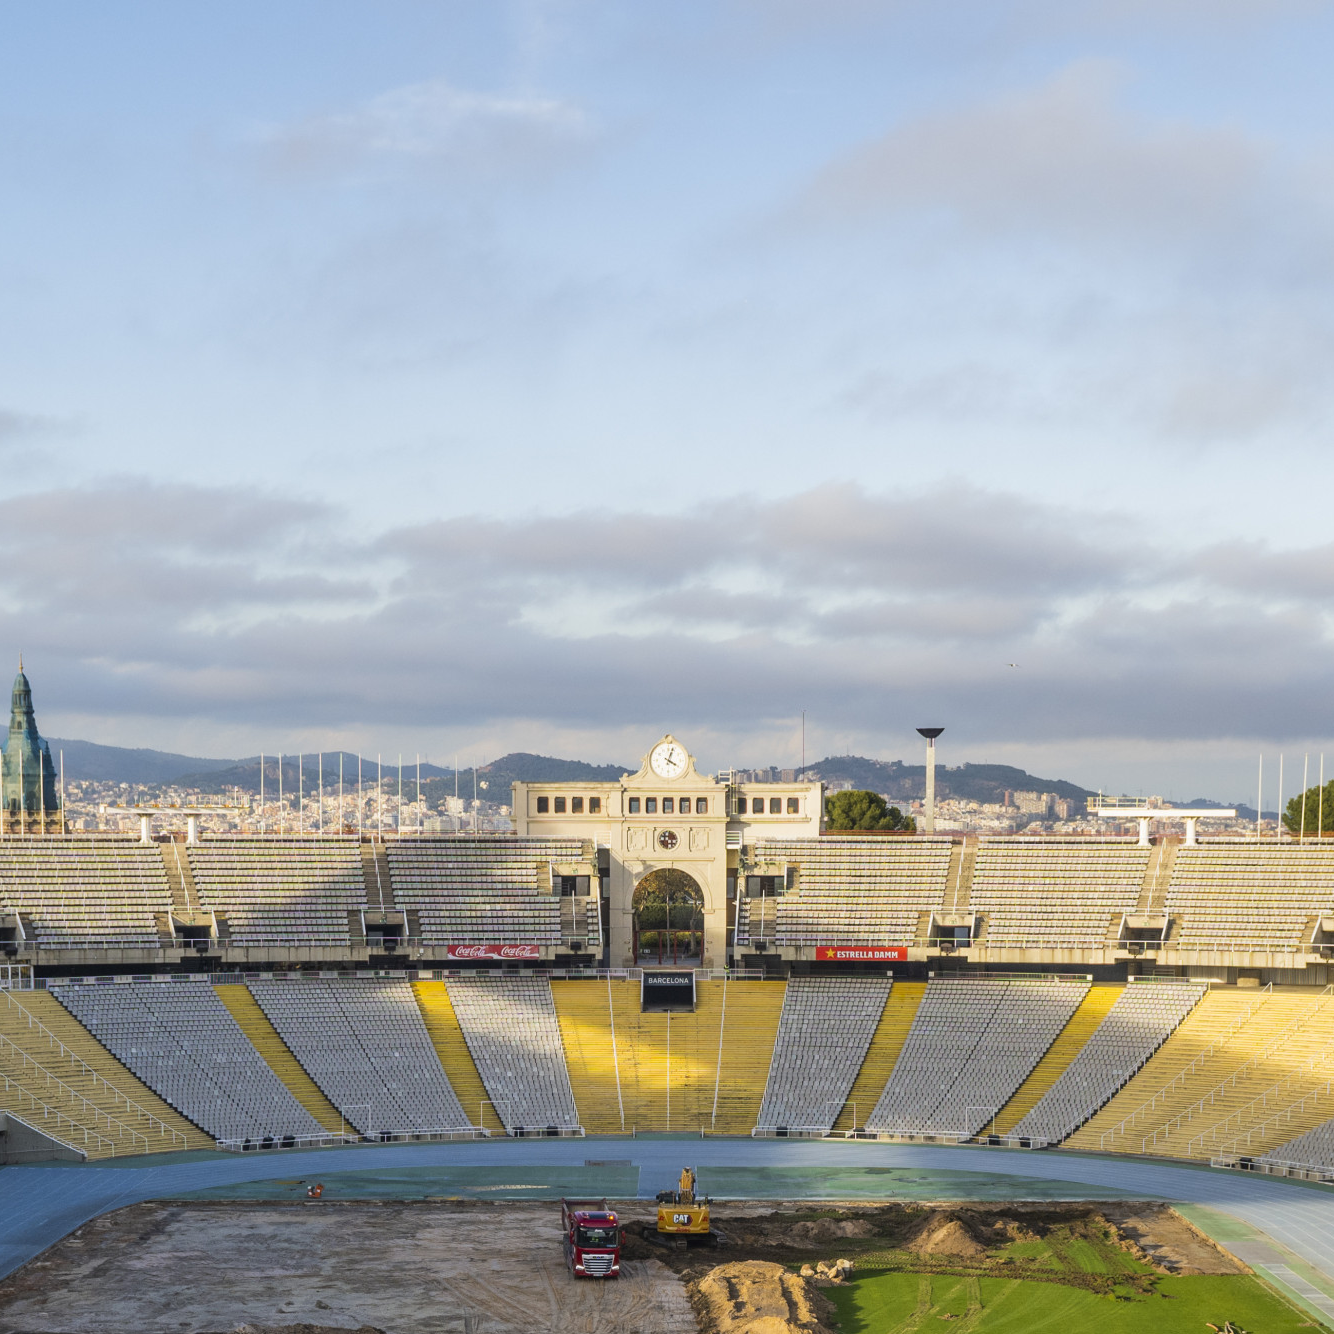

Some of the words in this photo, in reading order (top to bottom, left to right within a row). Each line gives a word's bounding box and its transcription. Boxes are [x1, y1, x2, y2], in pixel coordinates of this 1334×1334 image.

[837, 950, 873, 959] ESTRELLA
[874, 950, 898, 959] DAMM
[673, 1214, 689, 1224] CAT
